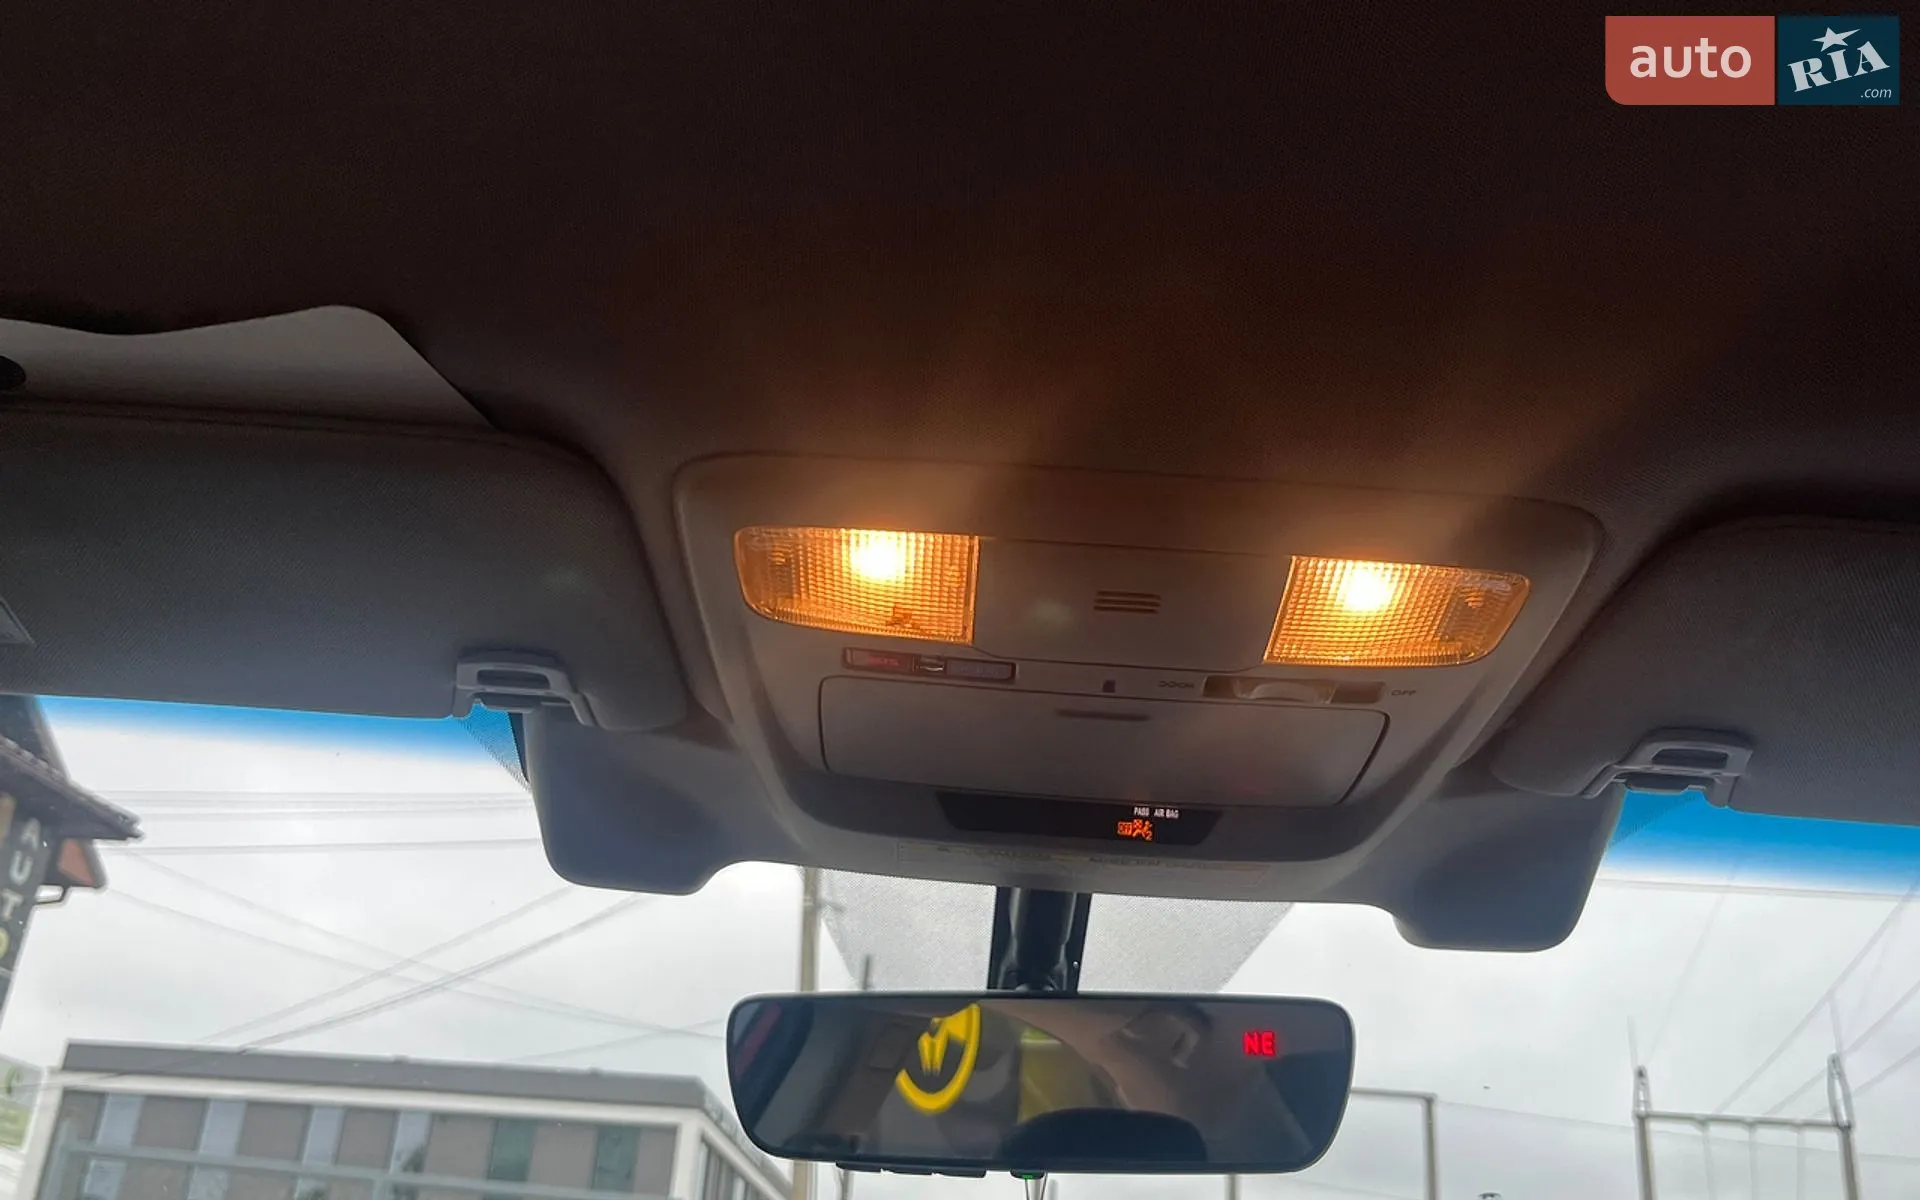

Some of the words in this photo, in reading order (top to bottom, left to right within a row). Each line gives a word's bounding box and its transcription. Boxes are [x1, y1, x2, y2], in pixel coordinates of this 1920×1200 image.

[1133, 807, 1151, 817] PASS
[1153, 808, 1165, 818] AIR
[1165, 808, 1180, 819] BAG
[1244, 1031, 1276, 1056] NE
